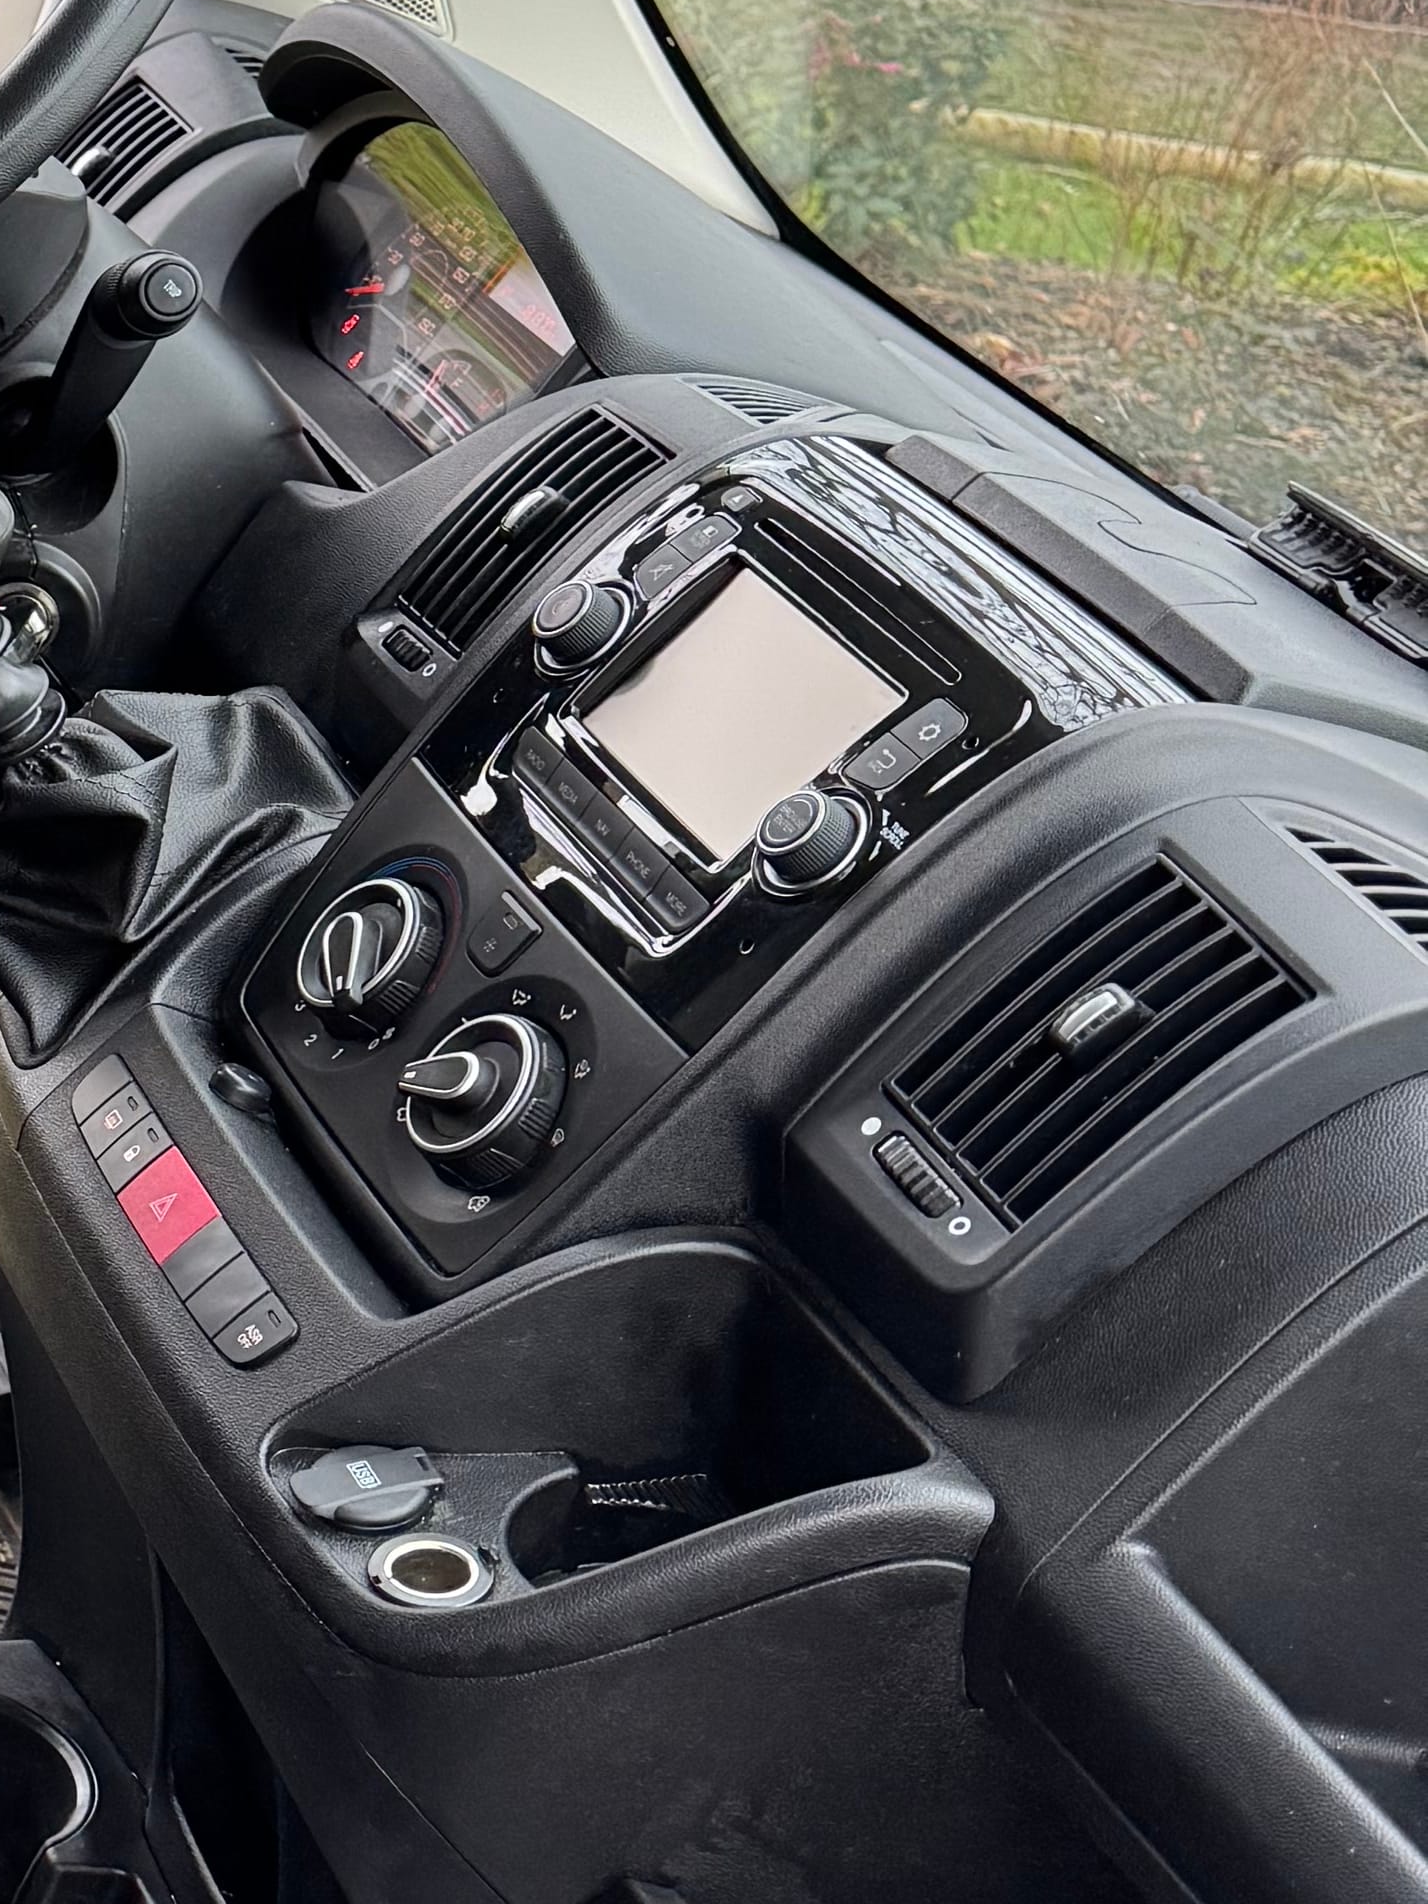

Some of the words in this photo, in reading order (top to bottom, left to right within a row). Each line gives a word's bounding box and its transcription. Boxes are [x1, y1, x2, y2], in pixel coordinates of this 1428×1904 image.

[163, 279, 182, 298] TRIP
[596, 818, 611, 837] NAV
[625, 851, 651, 879] PHONE
[666, 891, 687, 916] MORE
[304, 1034, 318, 1047] 2
[237, 1333, 253, 1349] OFF
[244, 1323, 263, 1345] ASR
[351, 1463, 375, 1485] USB
